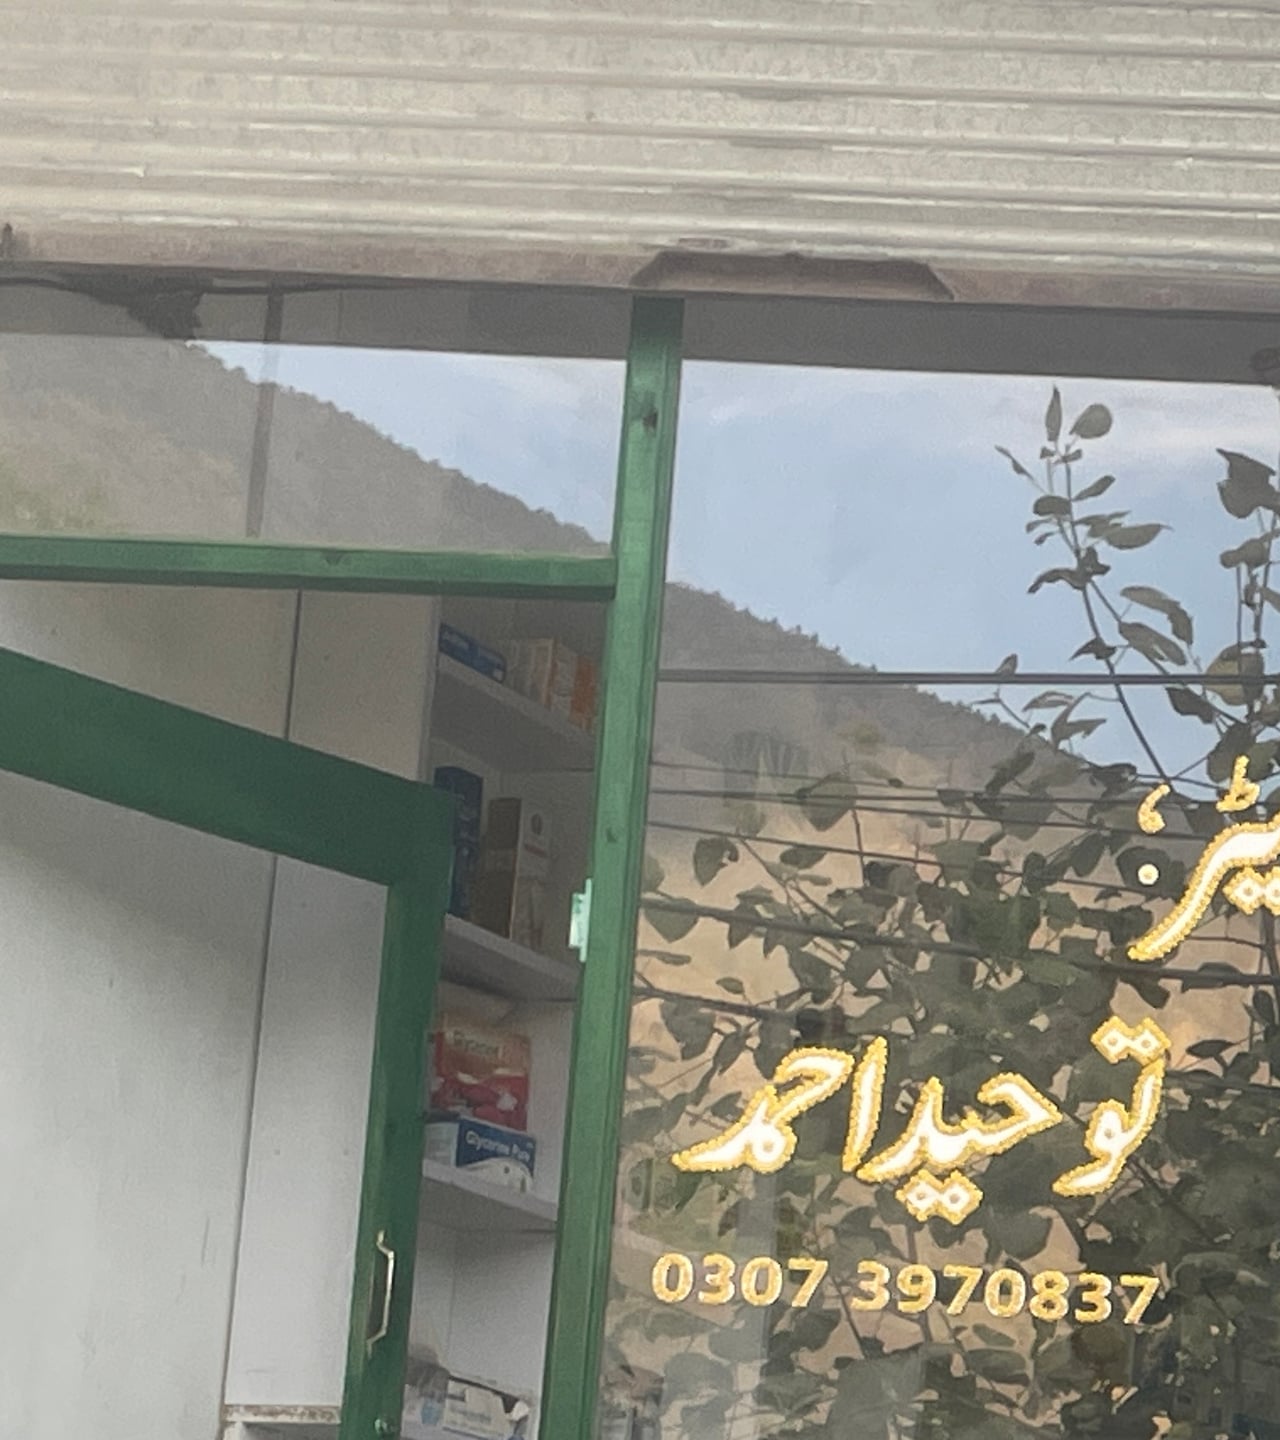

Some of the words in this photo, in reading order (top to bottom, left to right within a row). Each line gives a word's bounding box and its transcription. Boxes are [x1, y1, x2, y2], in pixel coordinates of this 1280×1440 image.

[670, 1036, 887, 1175] احمد
[650, 1251, 829, 1309] 0307
[851, 1258, 1162, 1326] 3970837
